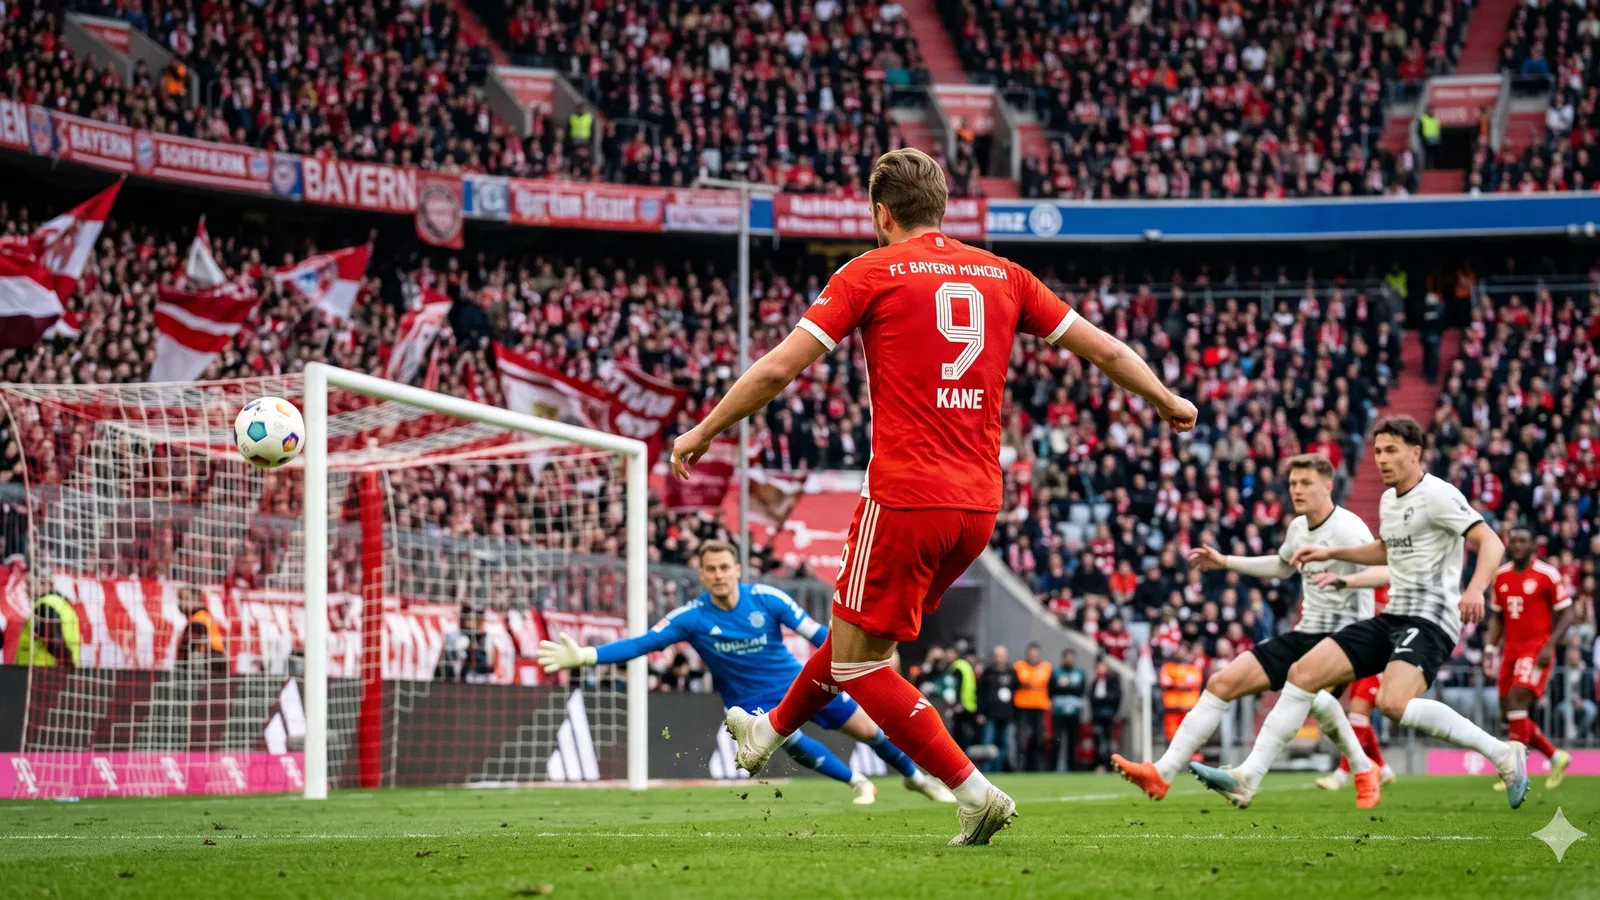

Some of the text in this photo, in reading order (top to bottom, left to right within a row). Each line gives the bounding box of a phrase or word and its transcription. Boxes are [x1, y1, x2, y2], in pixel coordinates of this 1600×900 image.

[69, 125, 134, 160] BAYERN
[302, 158, 418, 212] BAYERN
[889, 261, 1008, 280] FC BAYERN MUNCICH
[935, 281, 985, 380] 9
[936, 387, 985, 410] KANE
[836, 542, 850, 581] 9
[1401, 627, 1420, 647] 7
